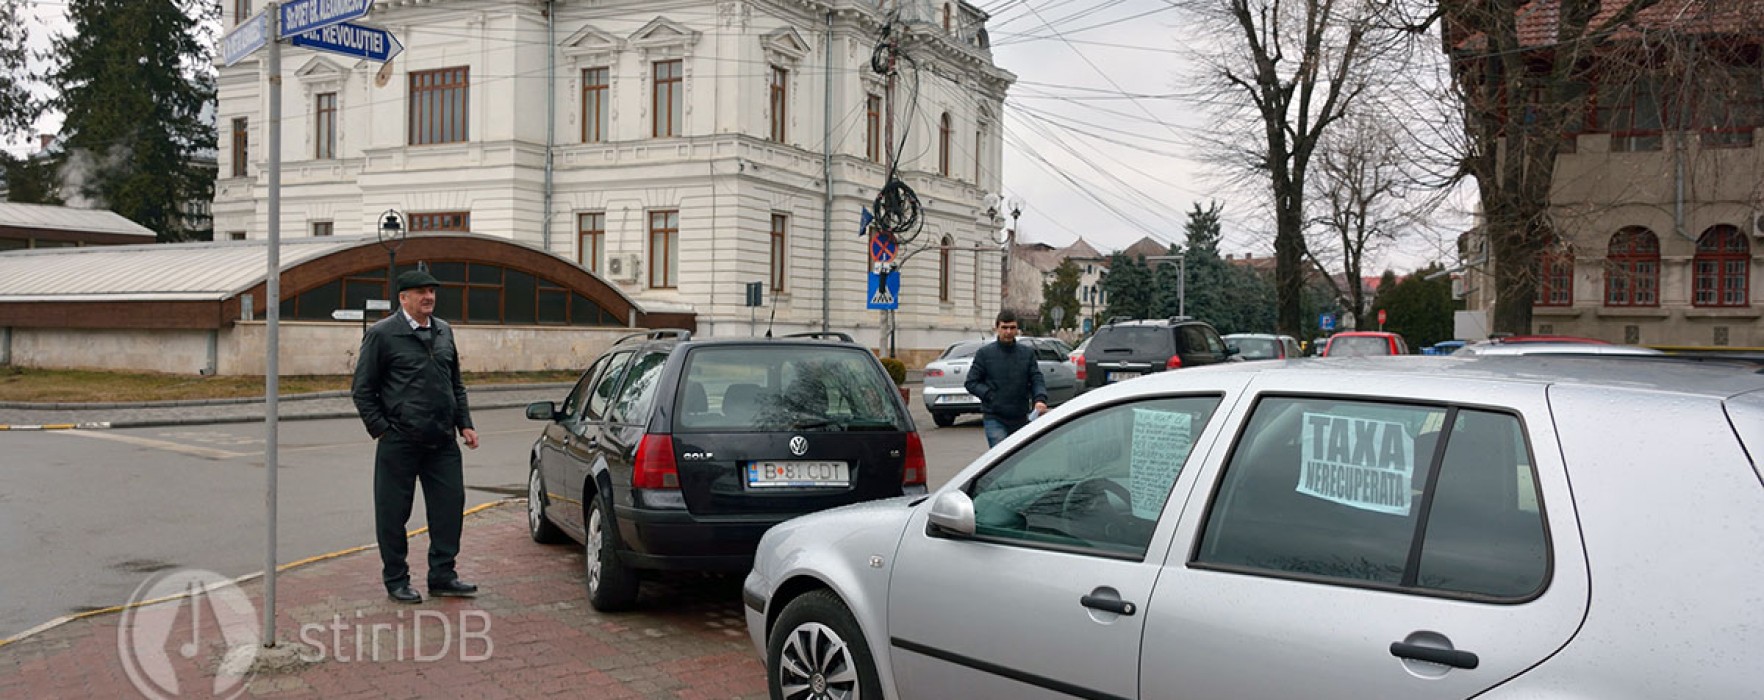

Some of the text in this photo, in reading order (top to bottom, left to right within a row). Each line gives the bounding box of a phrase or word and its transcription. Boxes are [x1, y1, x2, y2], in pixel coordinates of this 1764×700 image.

[1308, 415, 1406, 471] TAXA
[764, 463, 777, 479] B
[808, 463, 840, 480] CDT
[1305, 460, 1405, 508] NERECUPERATA
